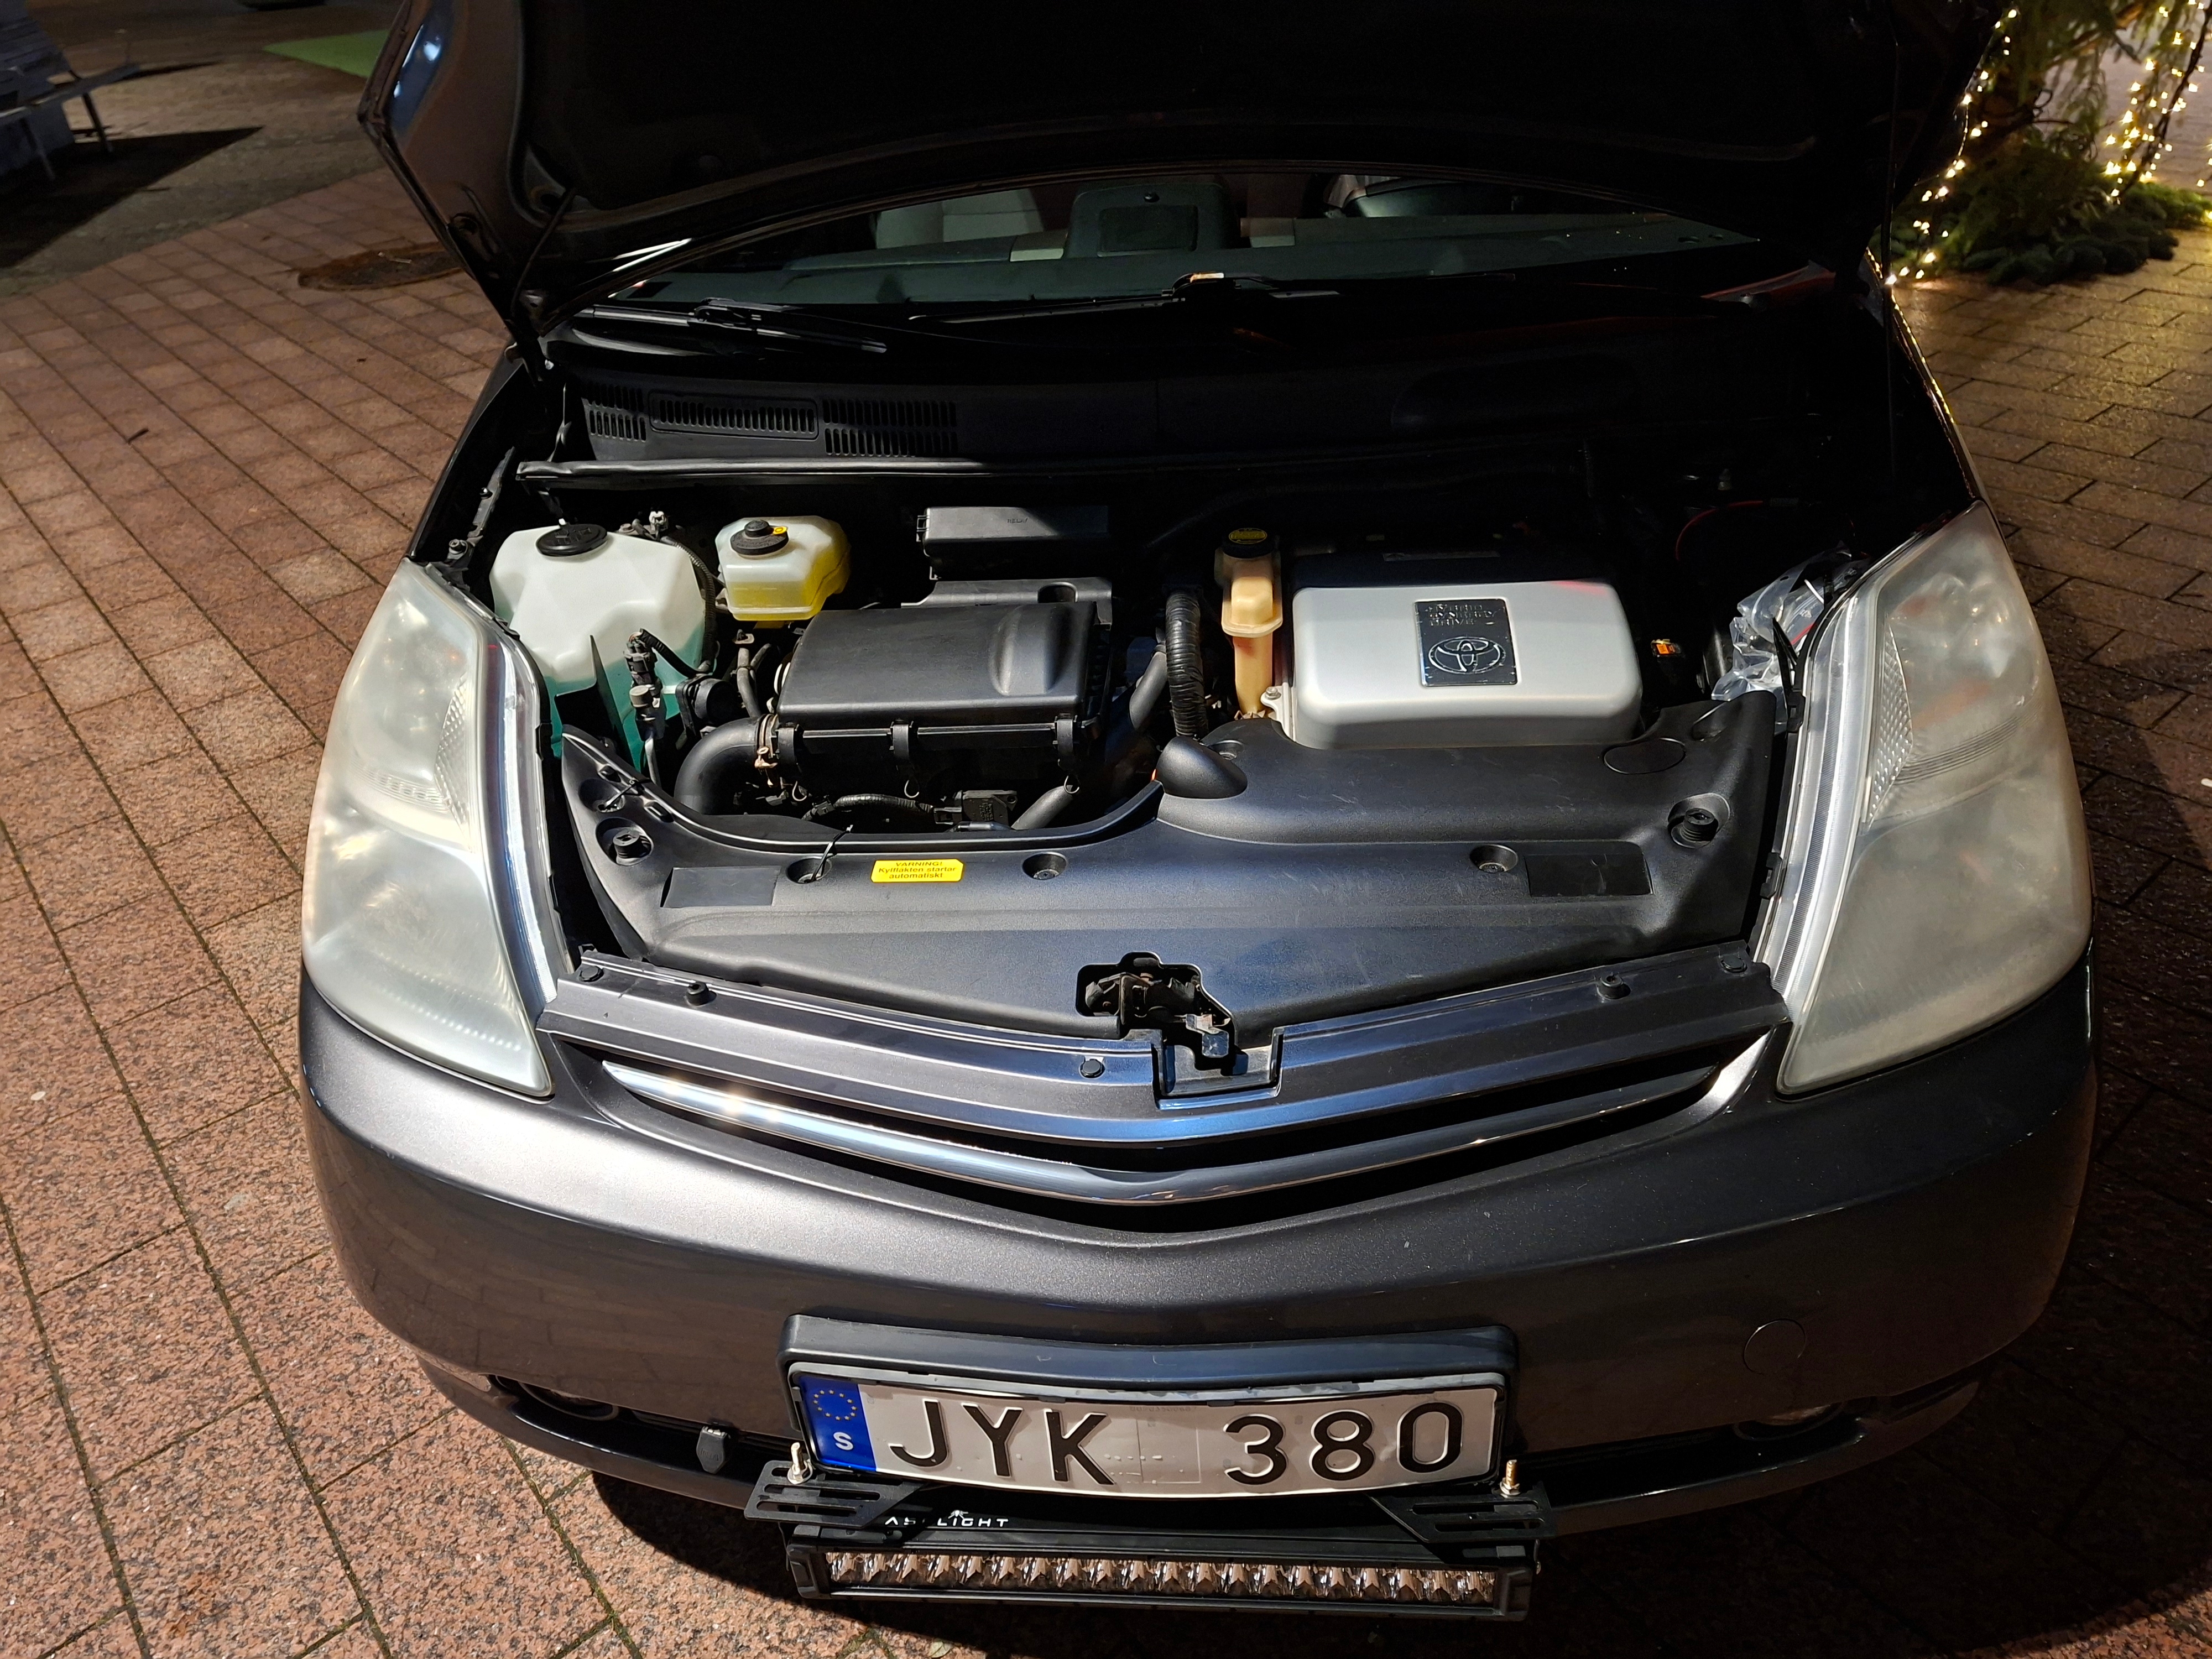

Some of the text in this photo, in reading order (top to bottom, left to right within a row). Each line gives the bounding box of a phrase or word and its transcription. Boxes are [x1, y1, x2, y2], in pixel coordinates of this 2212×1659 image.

[833, 1432, 854, 1451] S
[889, 1398, 1463, 1486] JYK 380
[884, 1516, 1009, 1527] ASLIGHT
